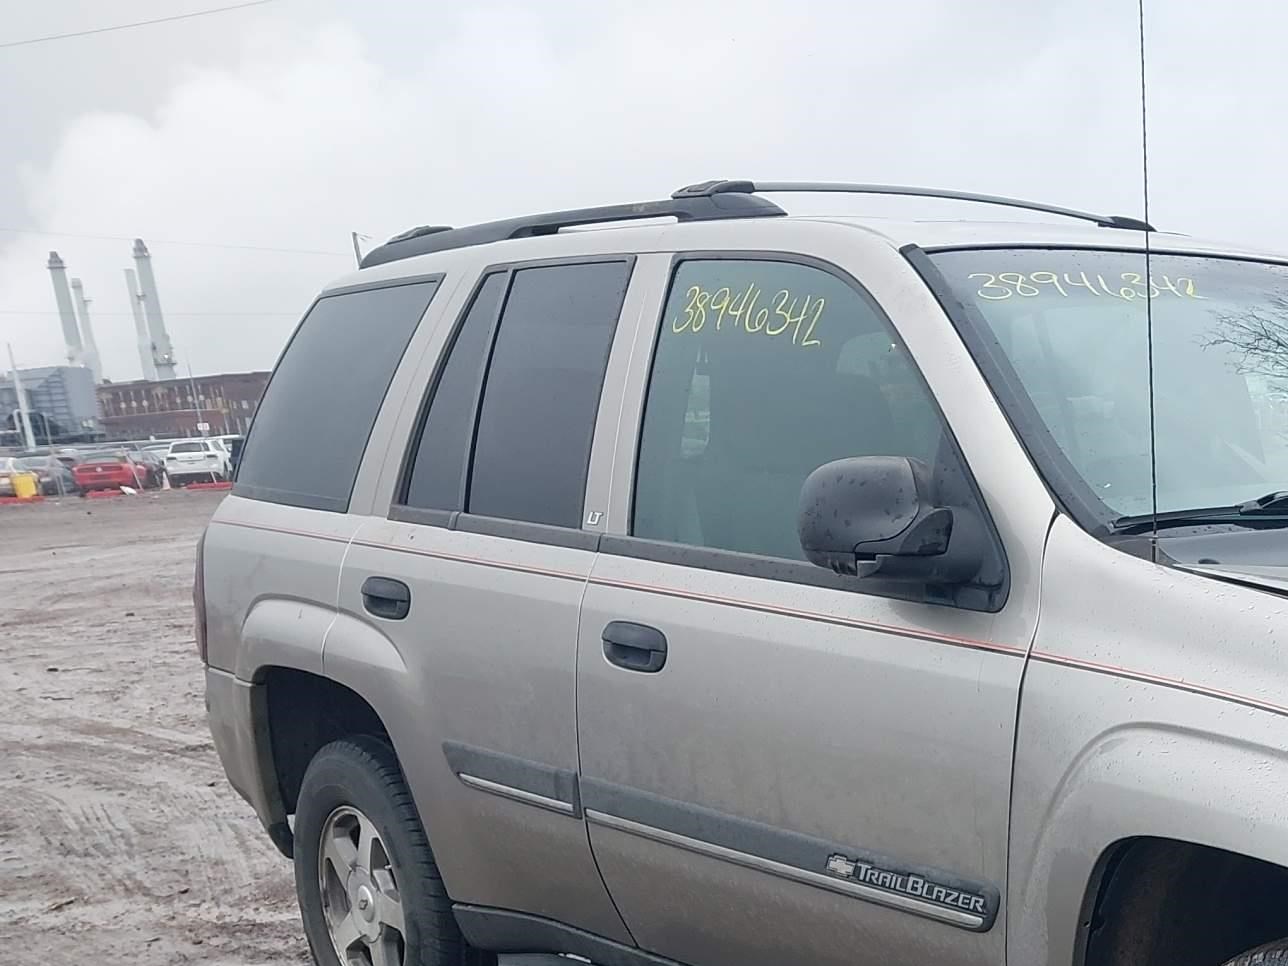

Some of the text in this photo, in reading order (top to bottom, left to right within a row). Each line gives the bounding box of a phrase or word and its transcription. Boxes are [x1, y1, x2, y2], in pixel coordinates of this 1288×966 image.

[967, 271, 1208, 301] 38946342
[672, 282, 825, 347] 38946342
[586, 511, 603, 525] LT
[857, 862, 986, 913] TRAILBLAZER
